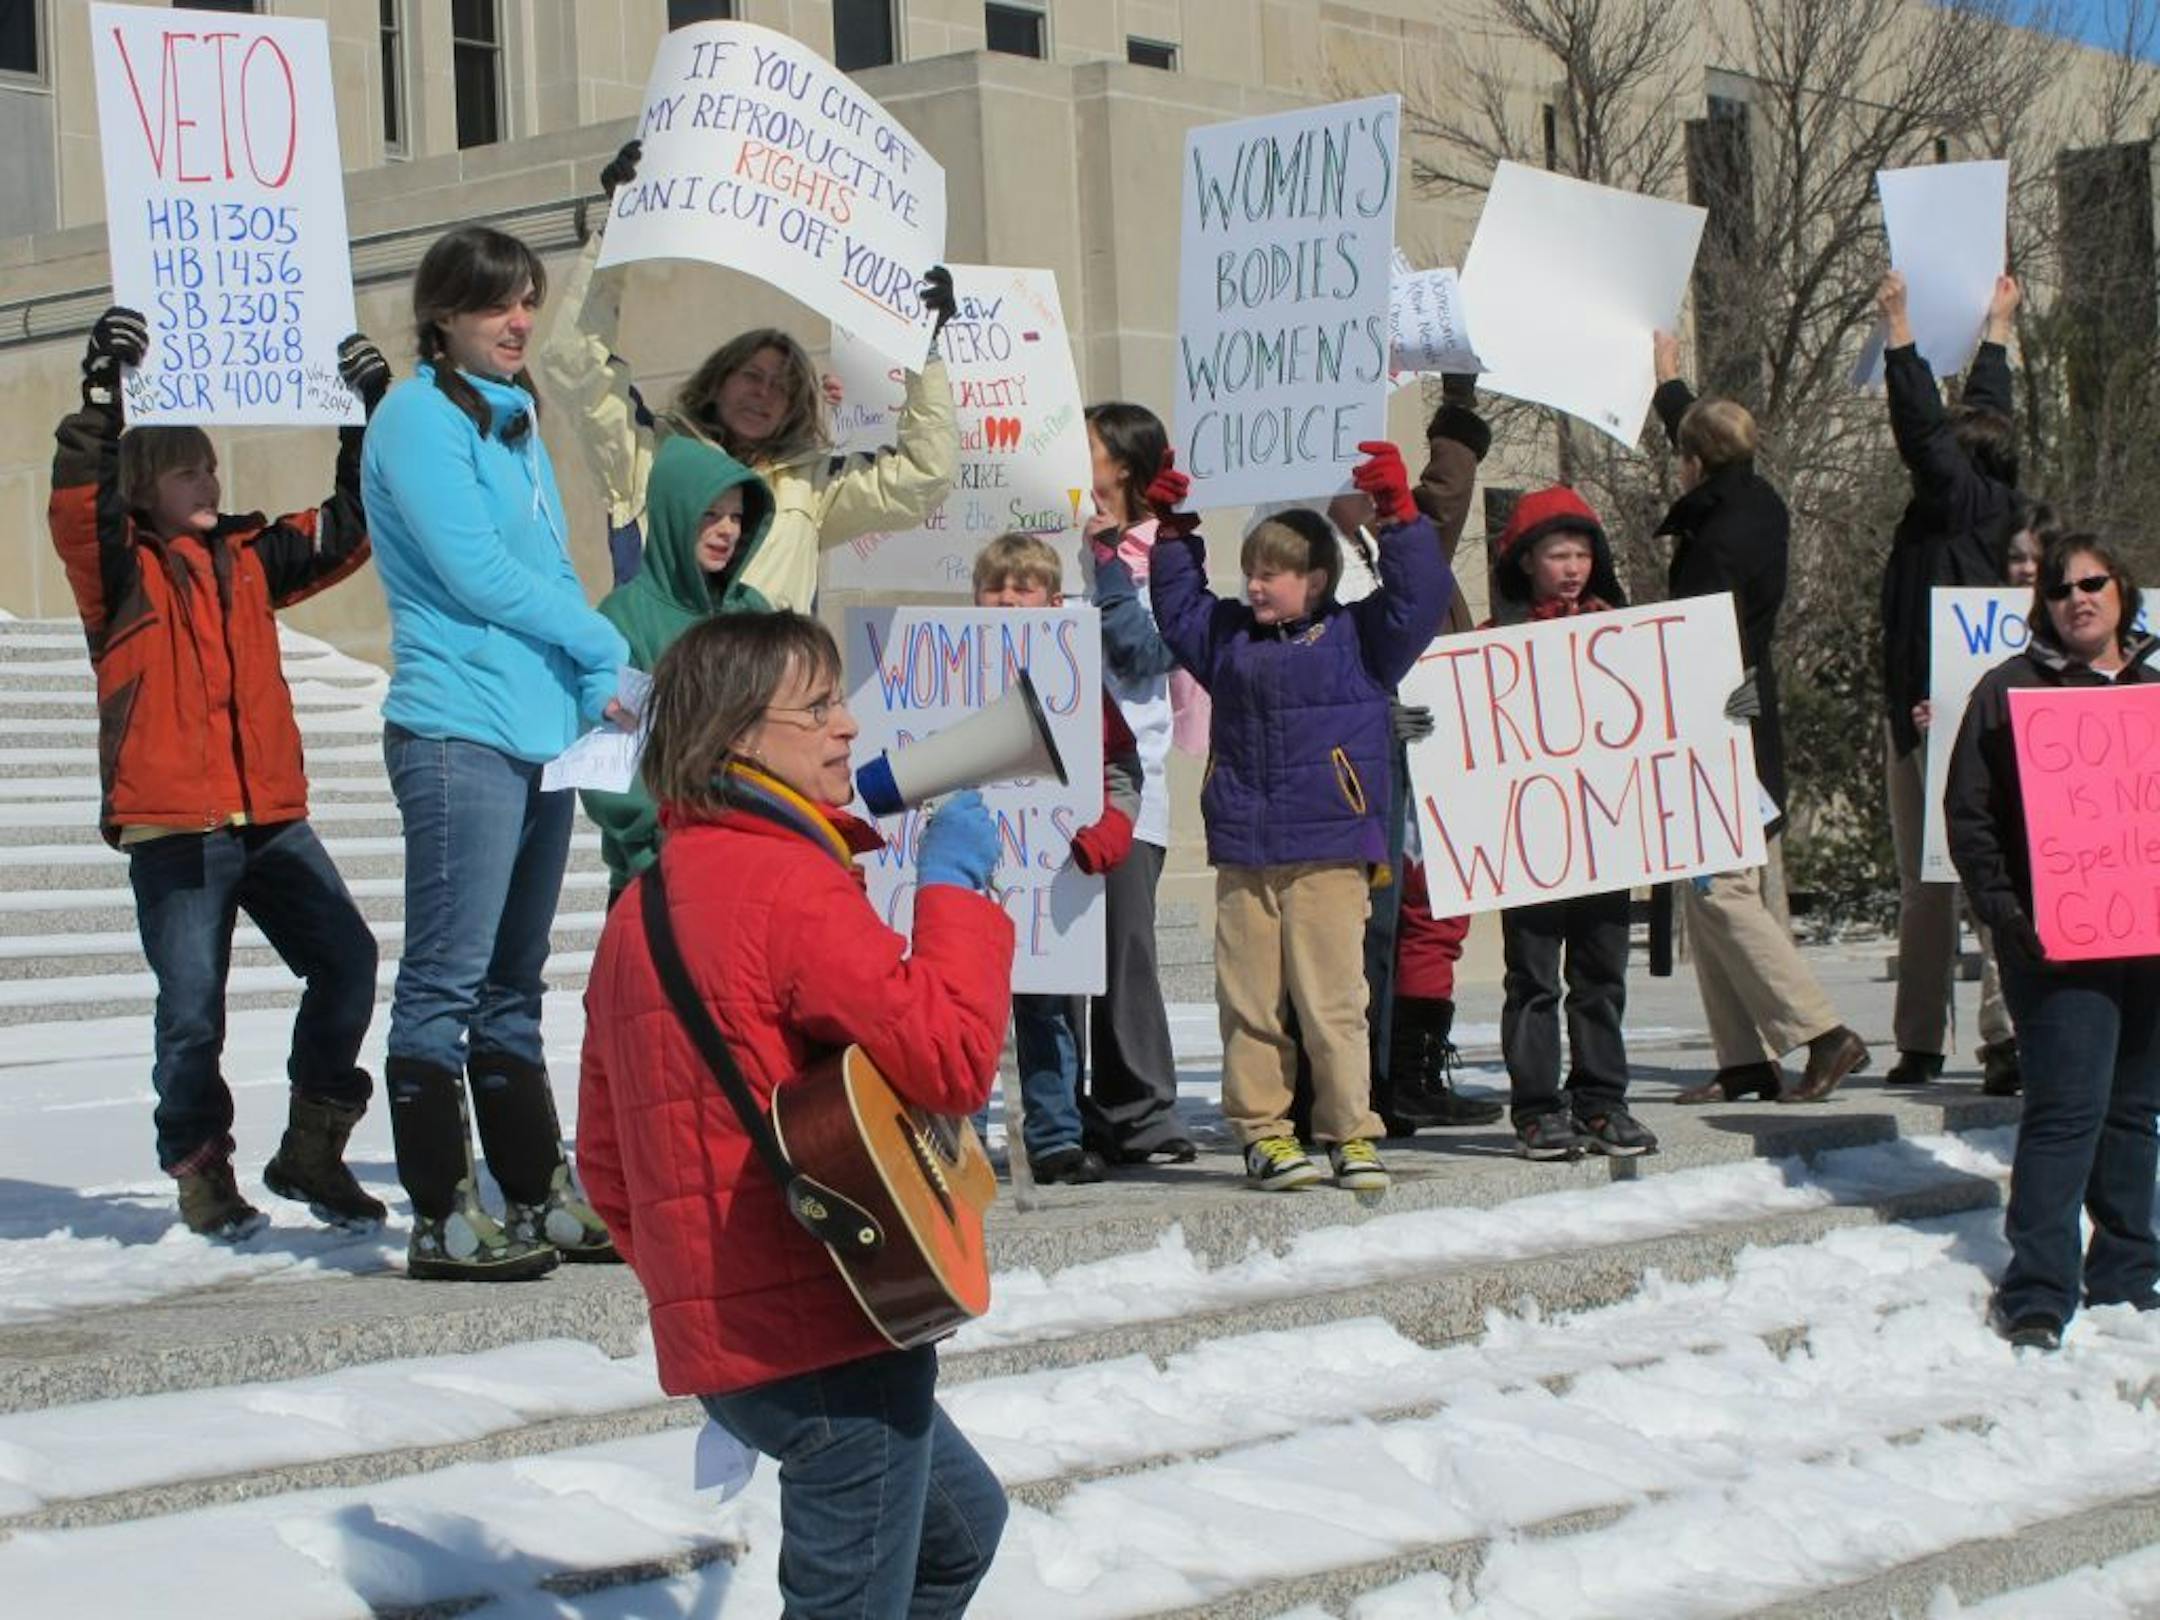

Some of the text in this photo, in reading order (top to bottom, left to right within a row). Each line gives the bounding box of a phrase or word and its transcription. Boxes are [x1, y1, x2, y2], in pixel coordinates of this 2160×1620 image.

[113, 27, 297, 188] VETO
[684, 41, 916, 173] IF YOU CUT OFF
[642, 93, 918, 228] MY REPRODUCTIVE
[735, 141, 856, 225] RIGHTS
[1194, 111, 1394, 233] WOMEN'S
[147, 199, 298, 244] HB 1305
[617, 179, 678, 219] CAN
[679, 177, 702, 210] I
[708, 180, 779, 227] CUT
[780, 207, 839, 258] OFF
[154, 247, 302, 289] HB 1456
[1216, 232, 1360, 312] BODIES
[157, 291, 304, 330] SB 2305
[163, 328, 304, 372] SB 2368
[159, 369, 303, 412] SCR 4009
[1181, 316, 1384, 403] WOMEN'S
[1189, 403, 1366, 479] CHOICE
[1419, 615, 1686, 770] TRUST
[2026, 706, 2156, 774] GOD
[1426, 738, 1743, 901] WOMEN
